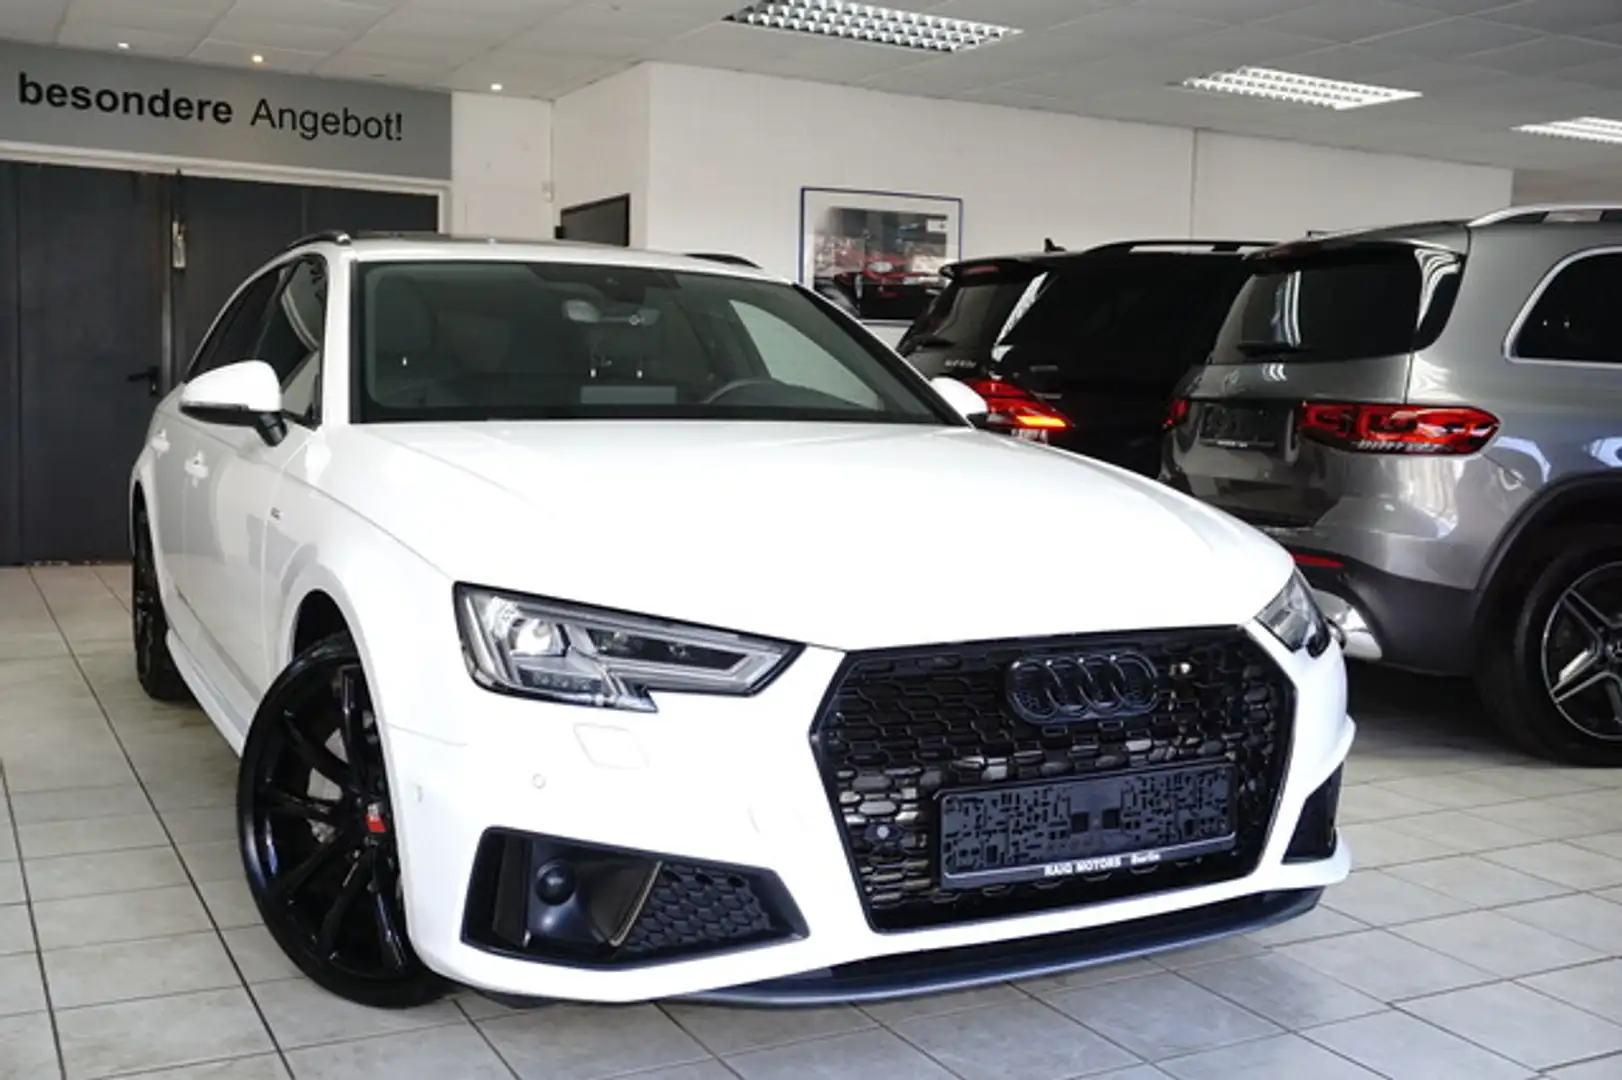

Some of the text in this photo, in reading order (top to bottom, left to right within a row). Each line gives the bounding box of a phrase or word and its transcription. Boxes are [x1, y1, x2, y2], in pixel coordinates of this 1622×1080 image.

[18, 71, 404, 141] besondere Angebot!
[1075, 856, 1122, 873] MOTORS
